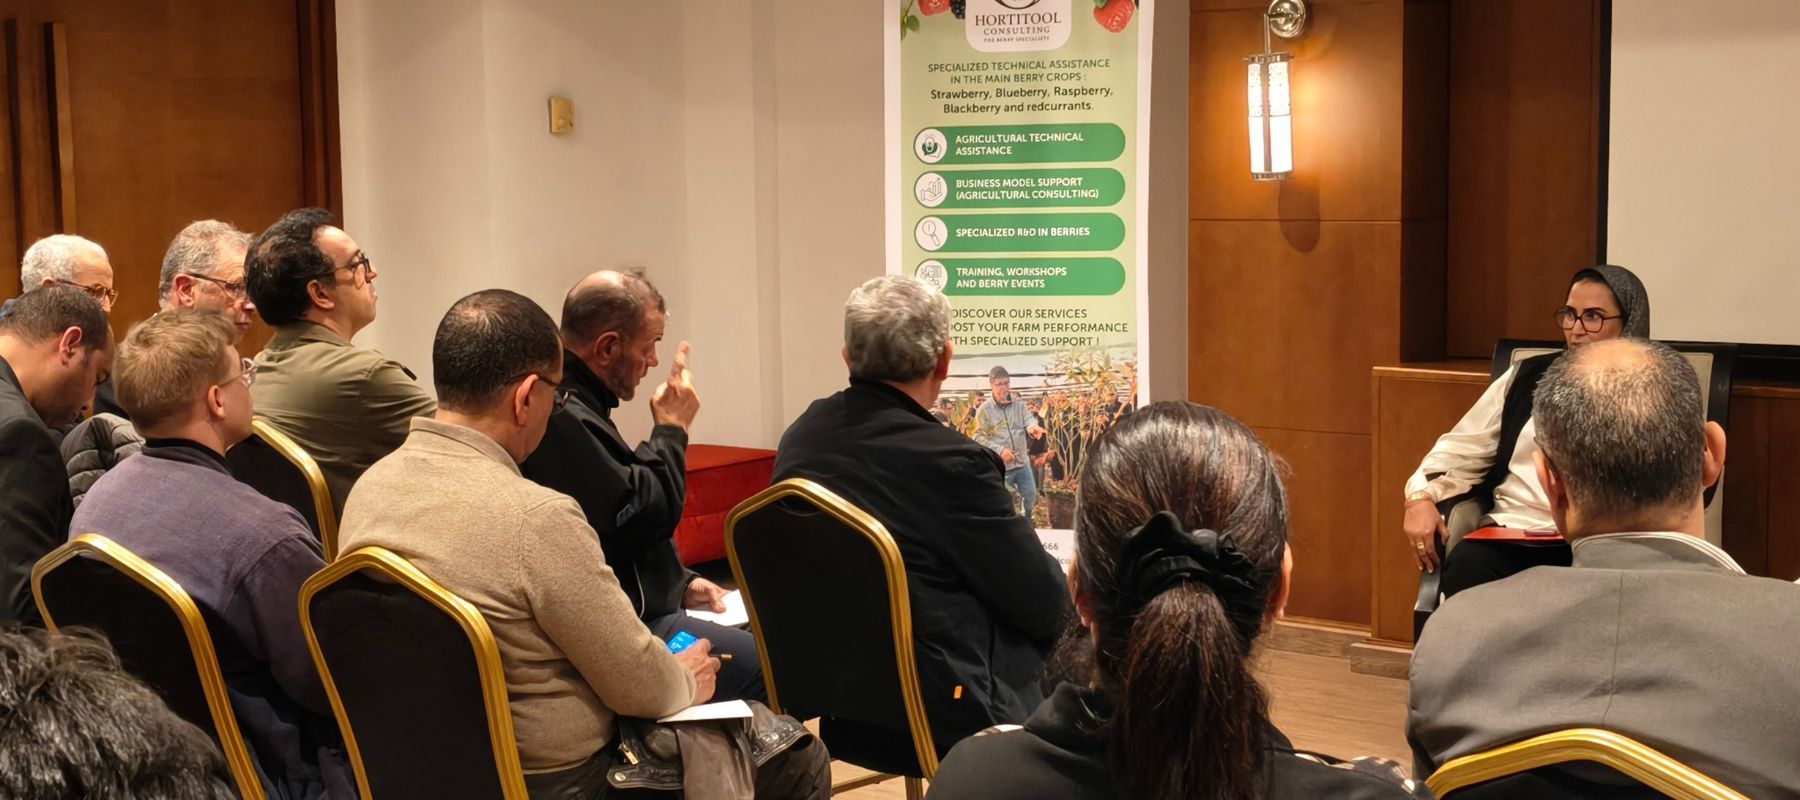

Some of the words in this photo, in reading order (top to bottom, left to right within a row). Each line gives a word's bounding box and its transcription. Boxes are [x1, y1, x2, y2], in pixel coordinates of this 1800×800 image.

[975, 12, 1061, 26] HORTITOOL
[983, 26, 1050, 35] CONSULTING
[928, 63, 989, 73] SPECIALIZED
[992, 61, 1047, 70] TECHNICAL
[1050, 59, 1110, 68] ASSISTANCE
[950, 75, 961, 84] IN
[963, 75, 982, 83] THE
[985, 74, 1012, 83] MAIN
[1014, 73, 1044, 82] BERRY
[1046, 72, 1081, 81] CROPS
[931, 89, 992, 101] Strawberry,
[995, 88, 1051, 99] Blueberry,
[1054, 86, 1113, 98] Raspberry,
[943, 103, 1001, 115] Blackberry
[1004, 102, 1024, 112] and
[1027, 101, 1094, 111] redcurrants.
[956, 134, 1027, 144] AGRICULTURAL
[1029, 133, 1084, 142] TECHNICAL
[956, 146, 1012, 156] ASSISTANCE
[956, 179, 1000, 188] BUSINESS
[1003, 178, 1036, 187] MODEL
[1038, 177, 1083, 186] SUPPORT
[956, 190, 1030, 200] (AGRICULTURAL
[1032, 189, 1099, 199] CONSULTING)
[956, 228, 1015, 237] SPECIALIZED
[1038, 228, 1048, 236] IN
[1051, 227, 1090, 236] BERRIES
[957, 268, 1004, 277] TRAINING,
[1007, 267, 1067, 276] WORKSHOPS
[956, 279, 976, 288] AND
[979, 279, 1009, 288] BERRY
[1011, 279, 1045, 288] EVENTS
[952, 308, 1006, 318] DISCOVER
[1009, 308, 1032, 318] OUR
[1034, 308, 1087, 318] SERVICES
[950, 322, 975, 332] OST
[978, 322, 1008, 332] YOUR
[1012, 322, 1040, 332] FARM
[1044, 322, 1128, 332] PERFORMANCE
[970, 336, 1038, 346] SPECIALIZED
[1040, 336, 1092, 346] SUPPORT
